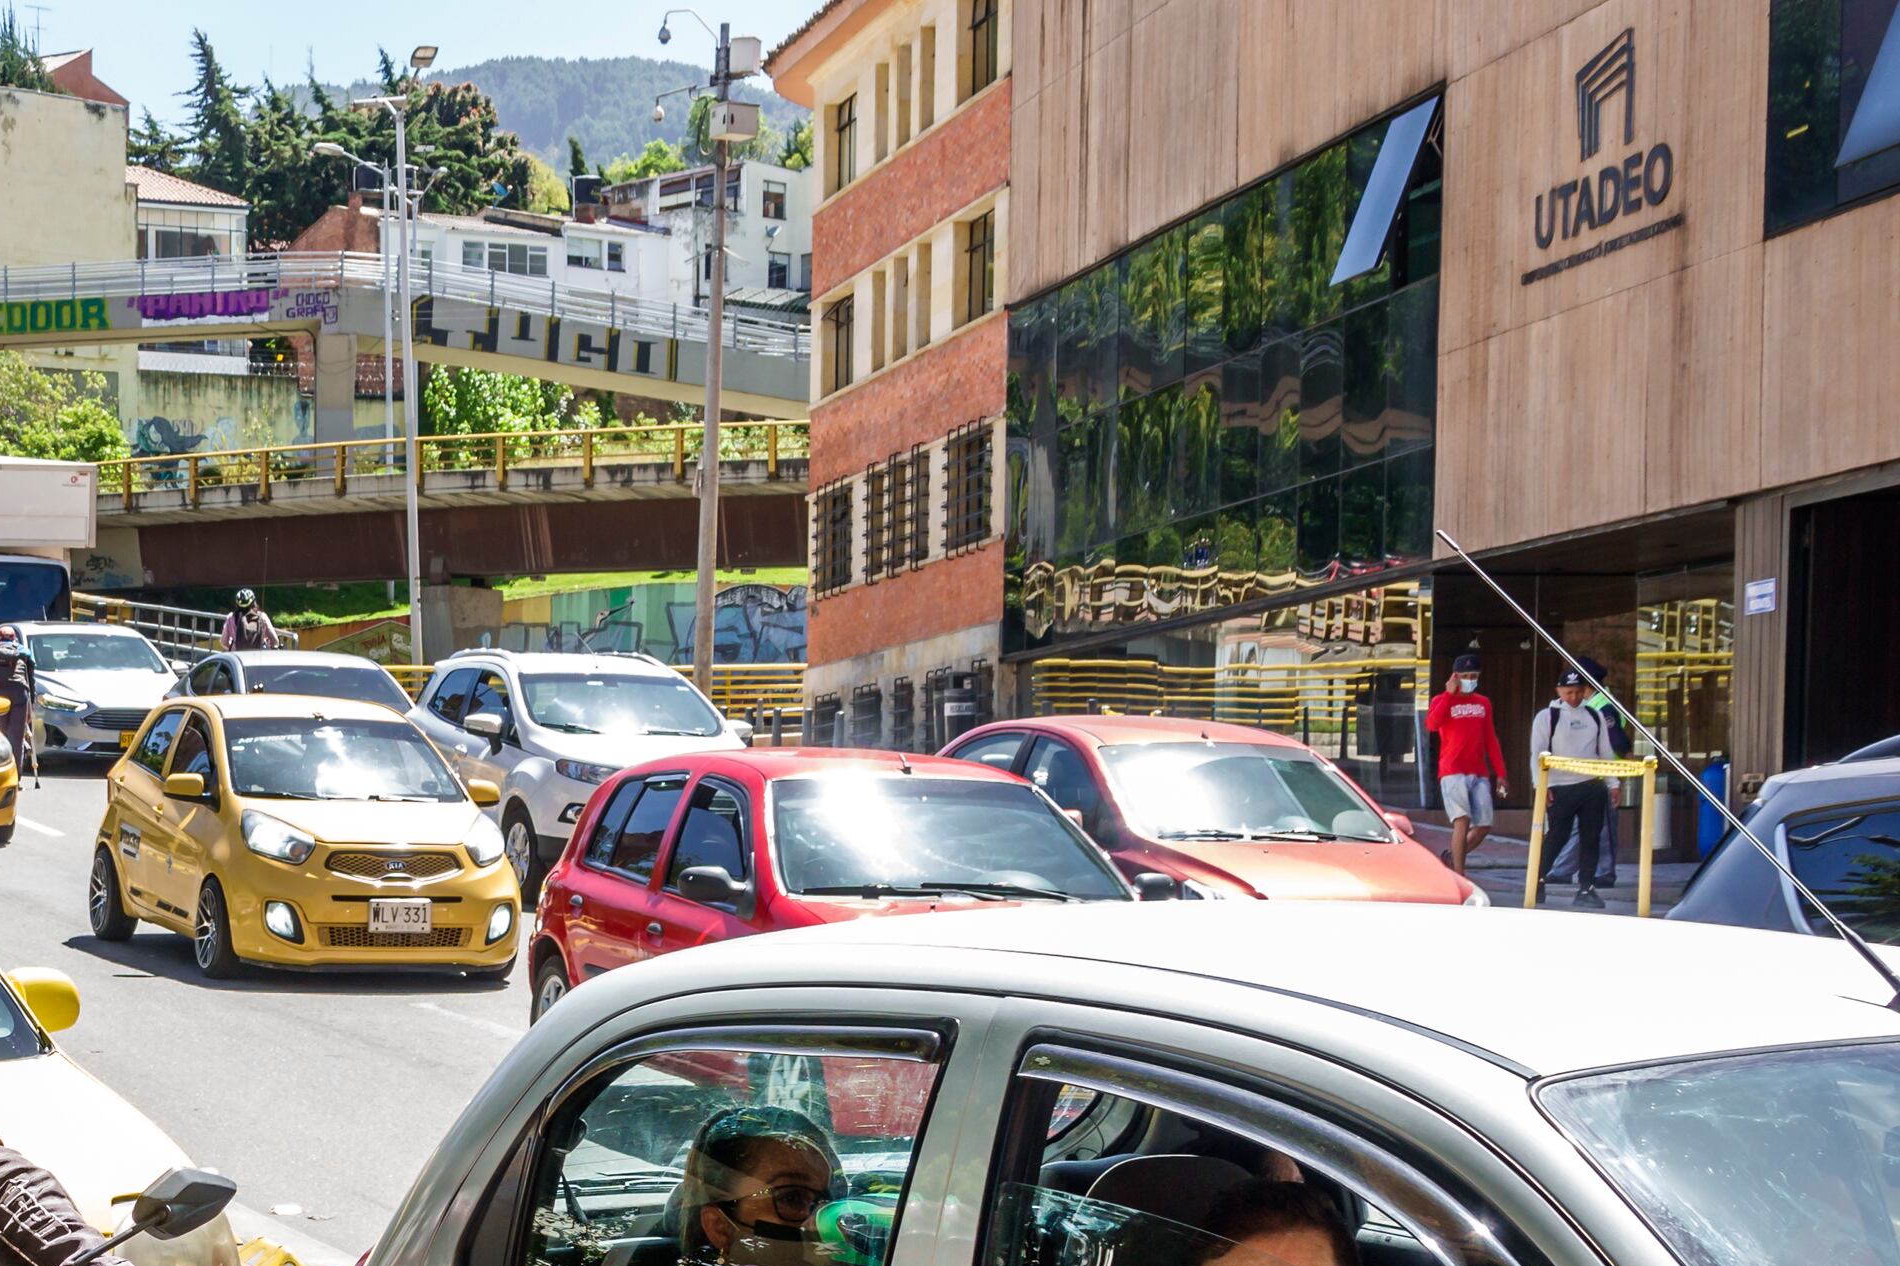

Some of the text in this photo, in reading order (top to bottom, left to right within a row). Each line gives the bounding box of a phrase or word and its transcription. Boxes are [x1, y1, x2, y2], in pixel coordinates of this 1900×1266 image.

[1534, 143, 1674, 250] UTADEO
[388, 861, 404, 870] KIA
[372, 906, 428, 923] WLV 331
